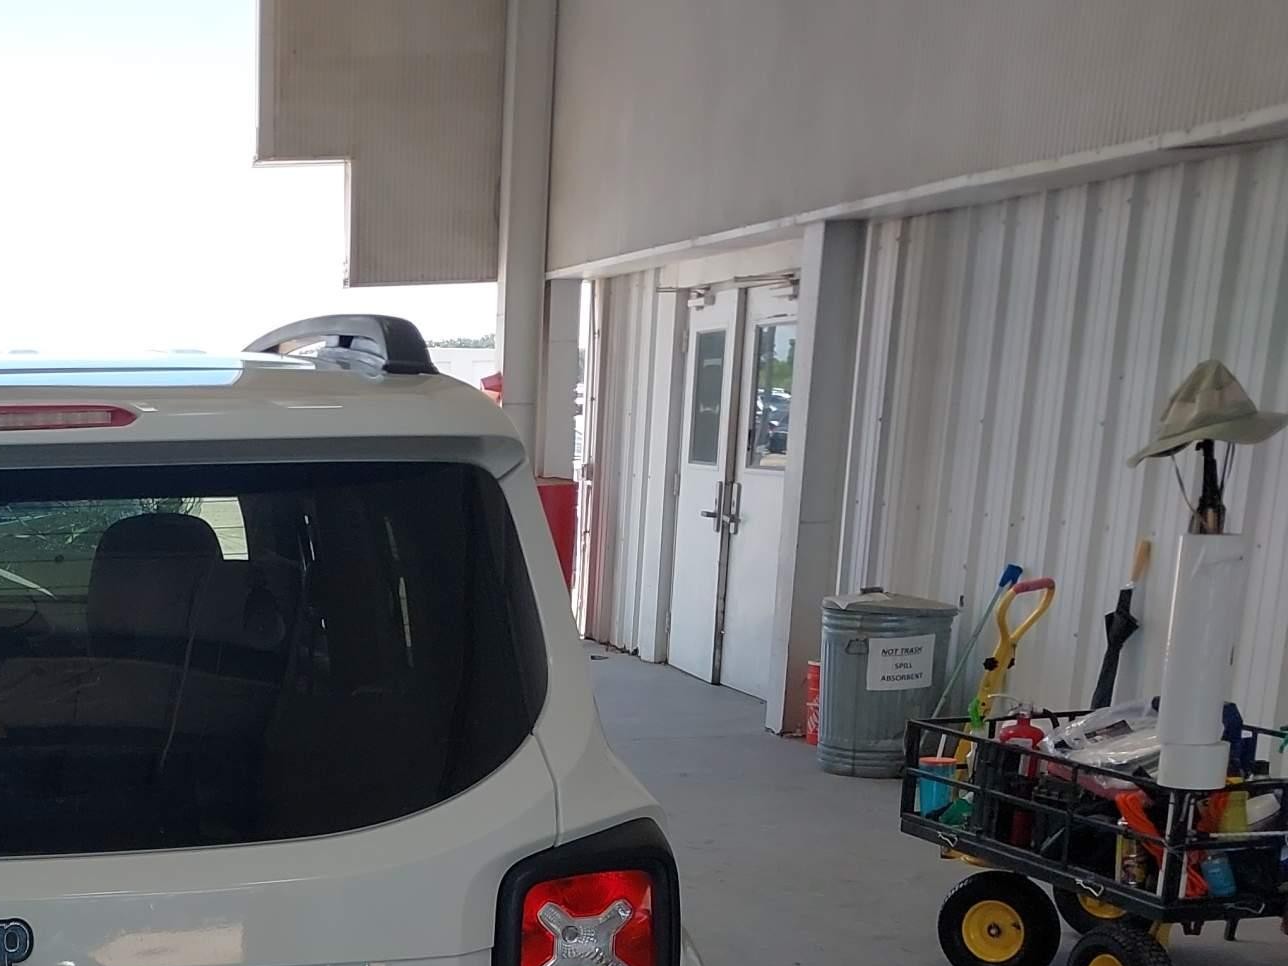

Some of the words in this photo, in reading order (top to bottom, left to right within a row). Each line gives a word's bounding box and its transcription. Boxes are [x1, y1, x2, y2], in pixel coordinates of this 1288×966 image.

[881, 648, 899, 656] NOT
[900, 646, 923, 655] TRASH
[880, 672, 923, 682] ABSORBENT
